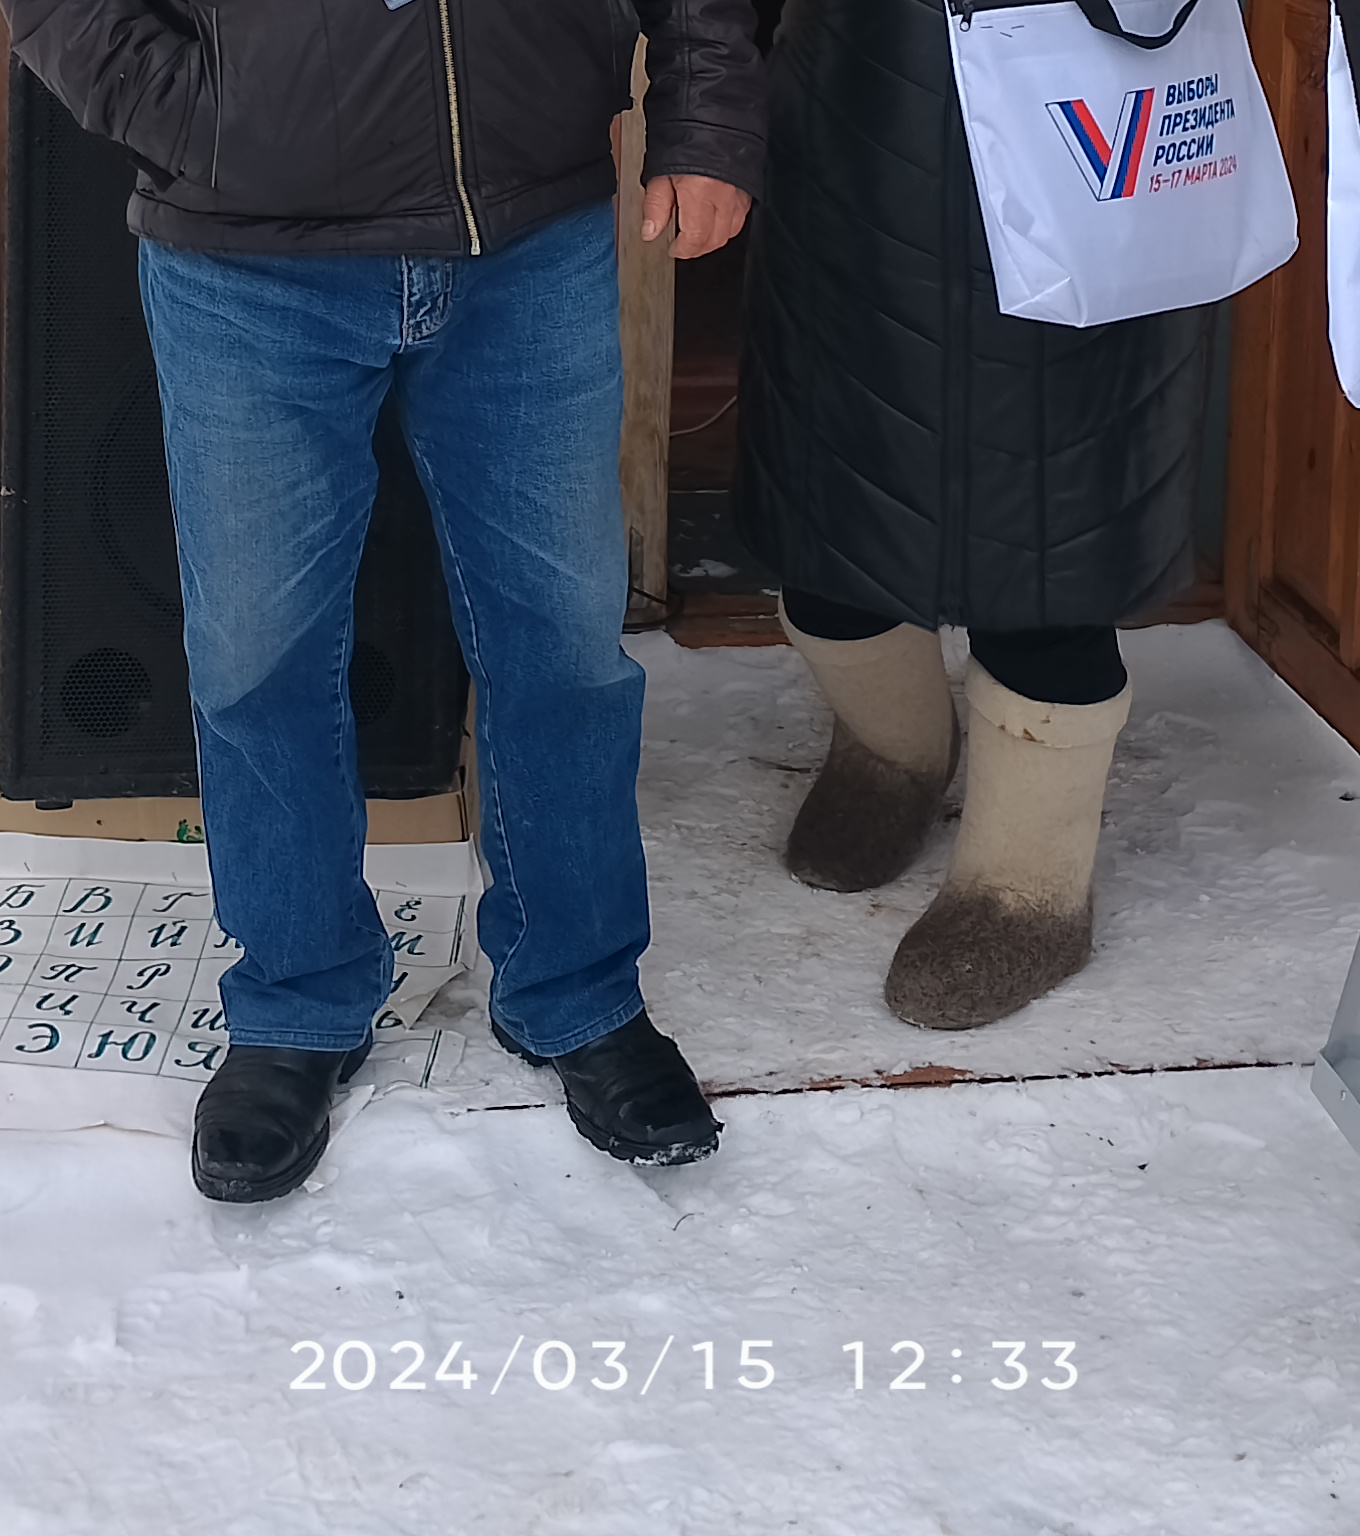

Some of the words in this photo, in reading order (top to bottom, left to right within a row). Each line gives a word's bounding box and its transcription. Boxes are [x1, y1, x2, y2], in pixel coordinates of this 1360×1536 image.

[1165, 73, 1219, 107] ВЫБОРЫ
[1159, 98, 1235, 137] ПРЕЗИДЕНТА
[1153, 133, 1214, 167] РОССИИ
[1183, 160, 1218, 186] МАРТА
[63, 885, 114, 914] В
[15, 1022, 60, 1054] Э
[87, 1029, 157, 1062] Ю
[174, 1041, 223, 1071] Я
